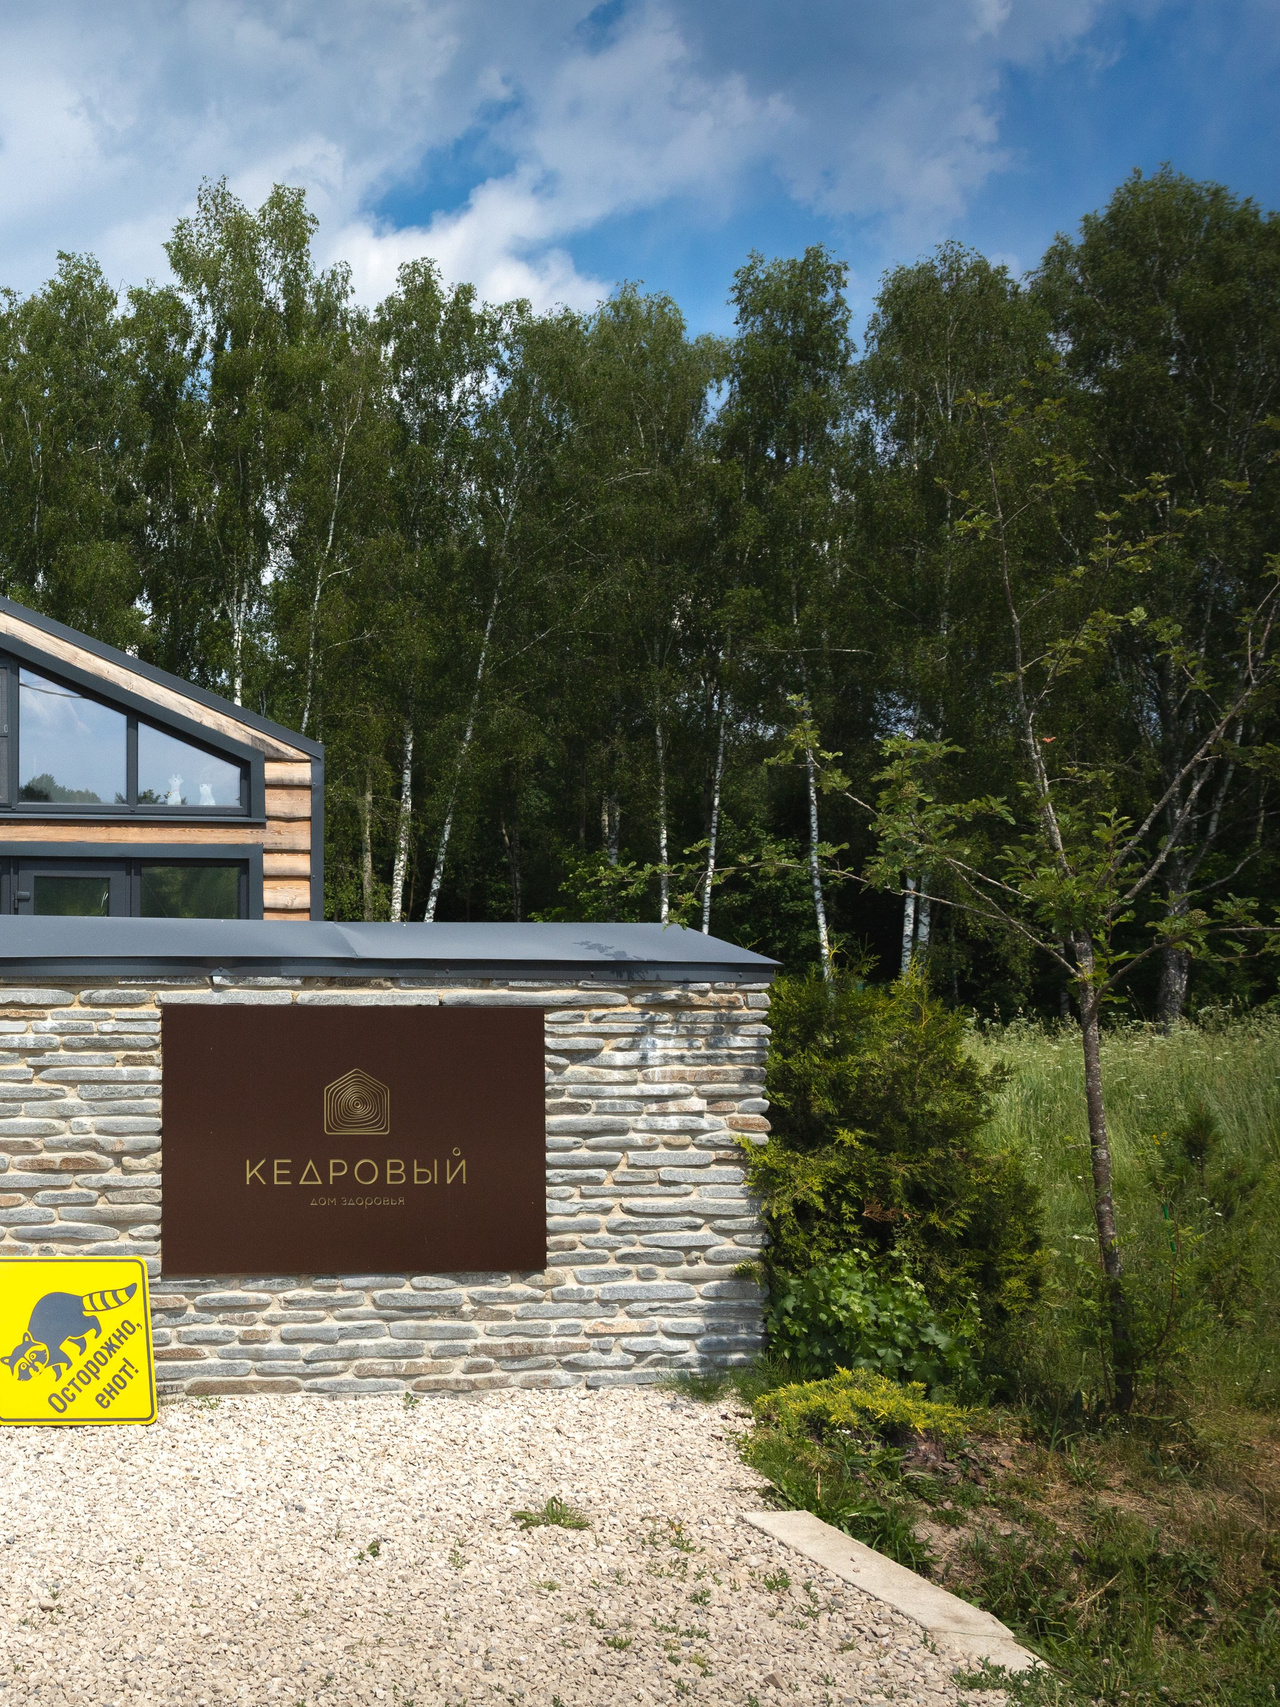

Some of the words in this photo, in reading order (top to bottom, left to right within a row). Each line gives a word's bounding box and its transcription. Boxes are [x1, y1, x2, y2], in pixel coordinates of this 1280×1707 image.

[245, 1147, 467, 1185] КЕДРОВЫЙ
[47, 1319, 143, 1414] Осторожно,
[94, 1357, 140, 1409] енот!
